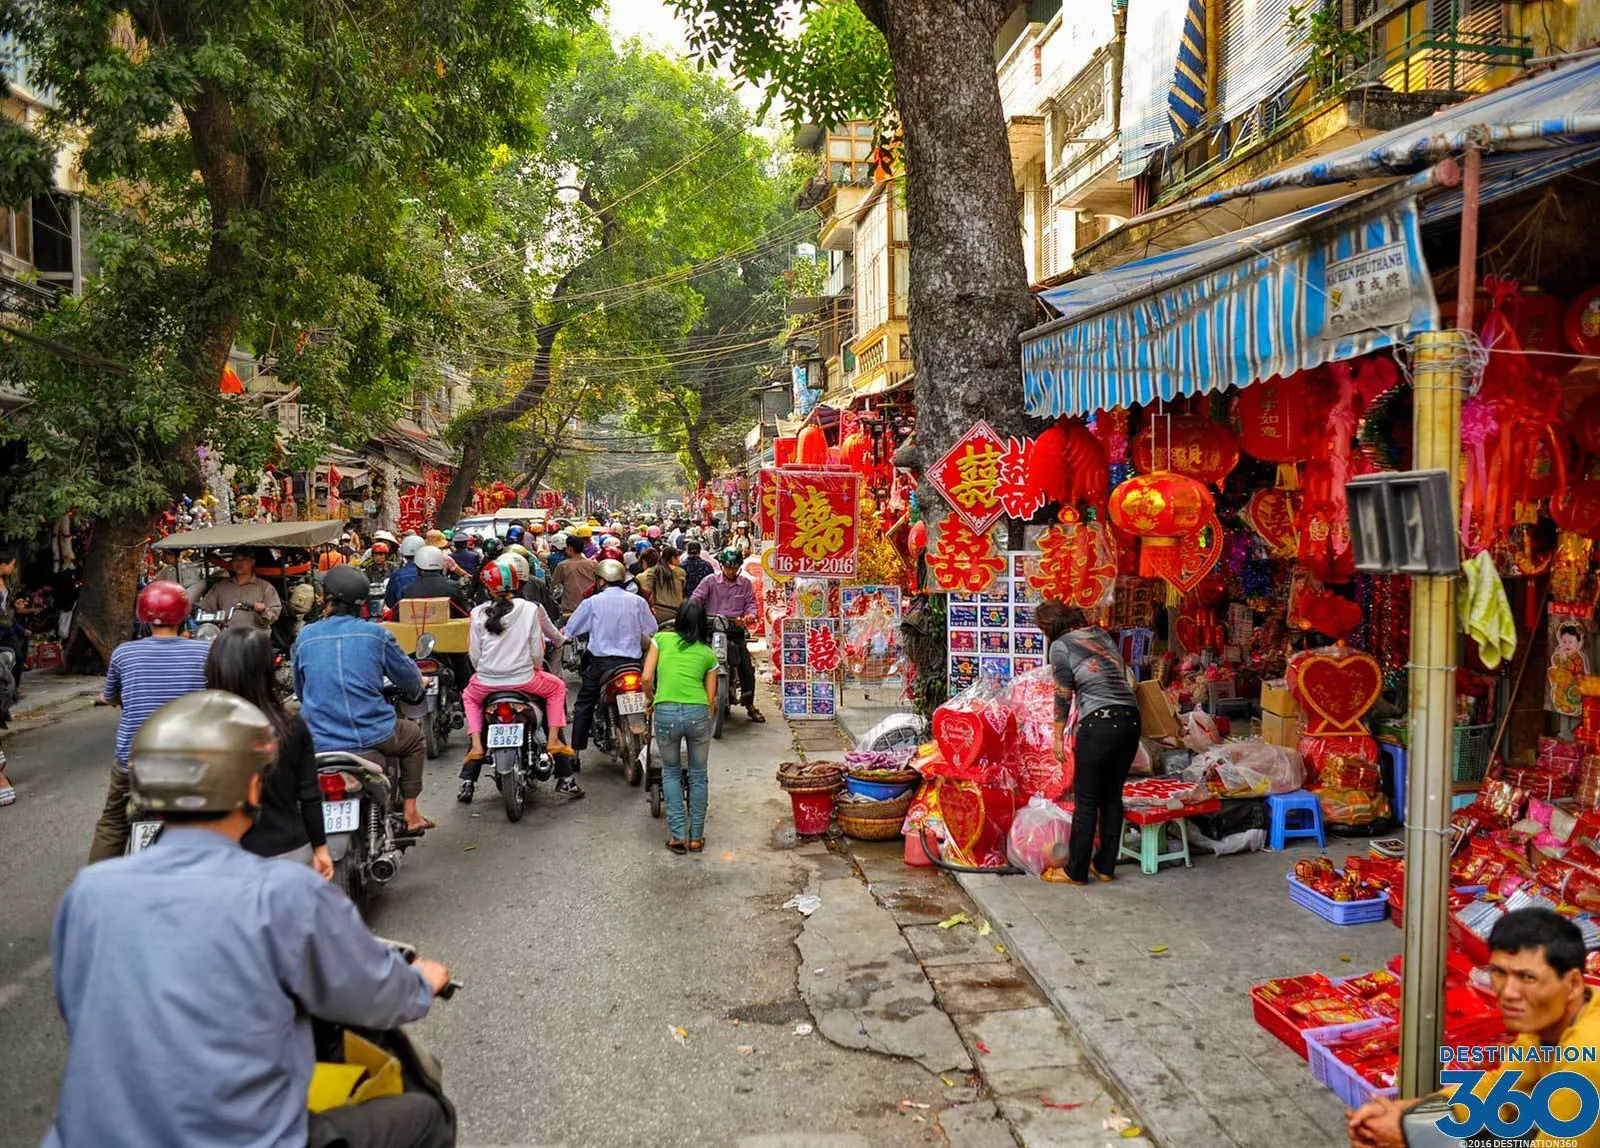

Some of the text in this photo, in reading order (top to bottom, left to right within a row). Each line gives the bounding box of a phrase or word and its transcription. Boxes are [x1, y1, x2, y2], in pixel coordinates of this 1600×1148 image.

[949, 444, 1003, 509] 囍
[926, 511, 1007, 592] 囍
[493, 735, 519, 746] 6362
